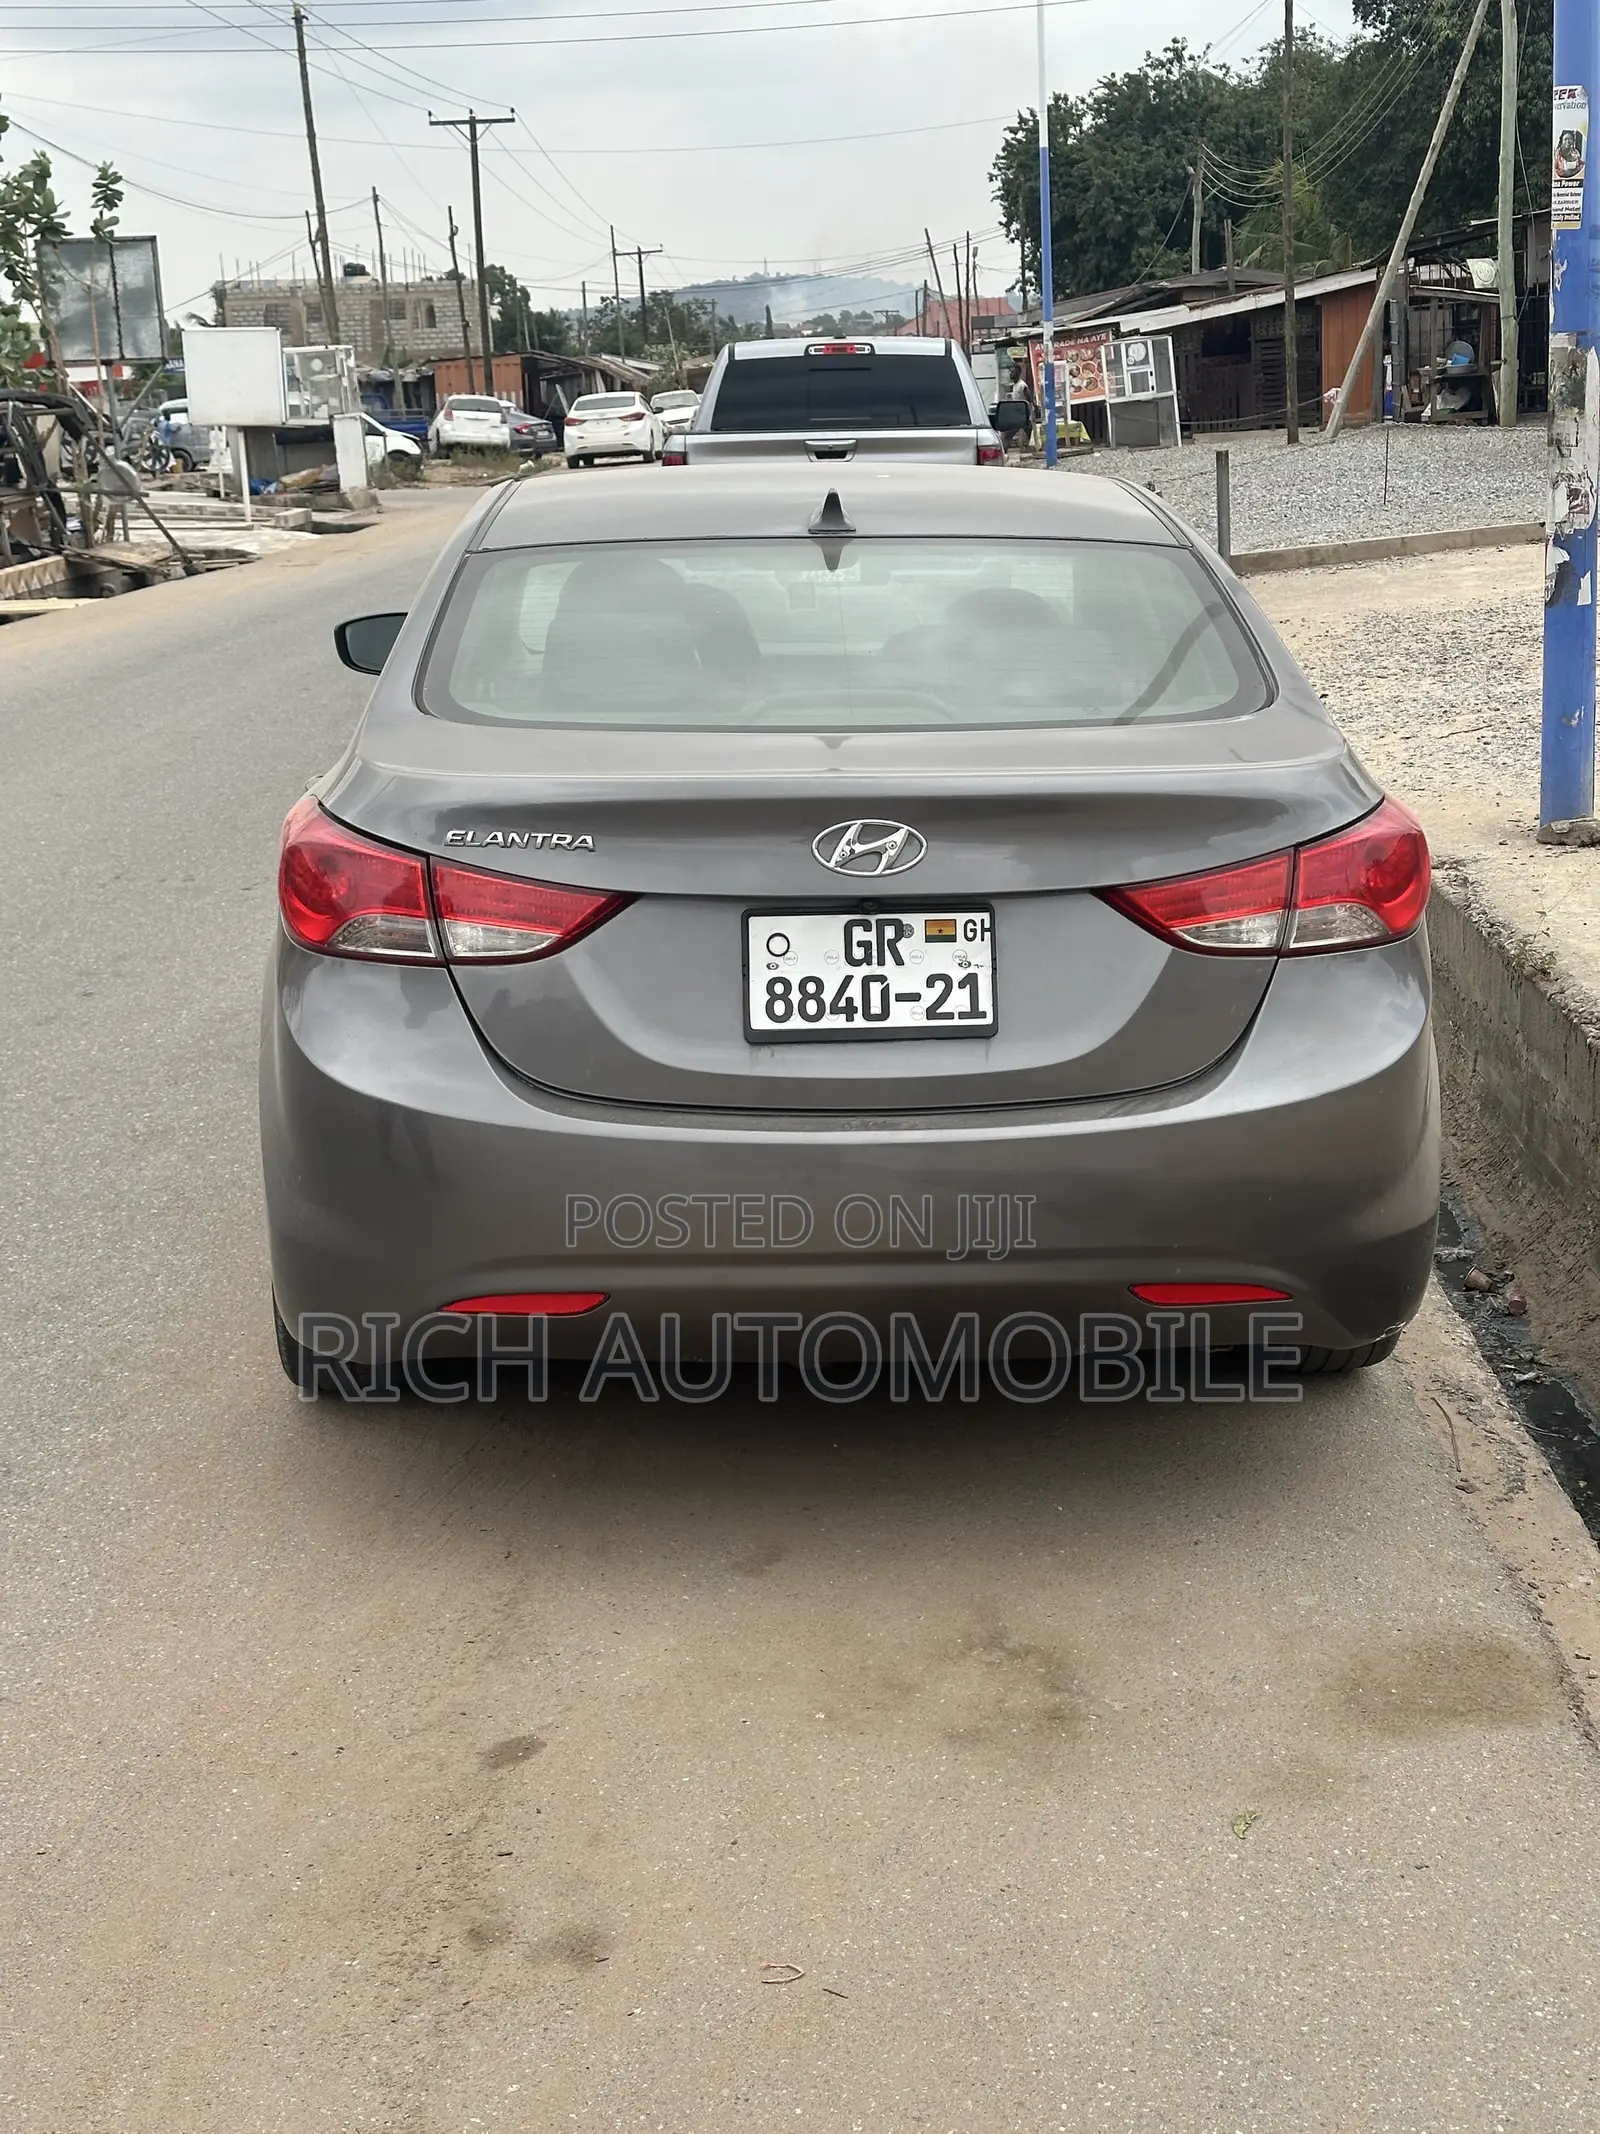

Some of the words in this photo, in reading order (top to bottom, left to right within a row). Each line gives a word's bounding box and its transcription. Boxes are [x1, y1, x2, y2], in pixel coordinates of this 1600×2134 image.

[444, 829, 596, 852] ELANTRA
[843, 918, 905, 967] GR
[765, 972, 988, 1023] 8840-21
